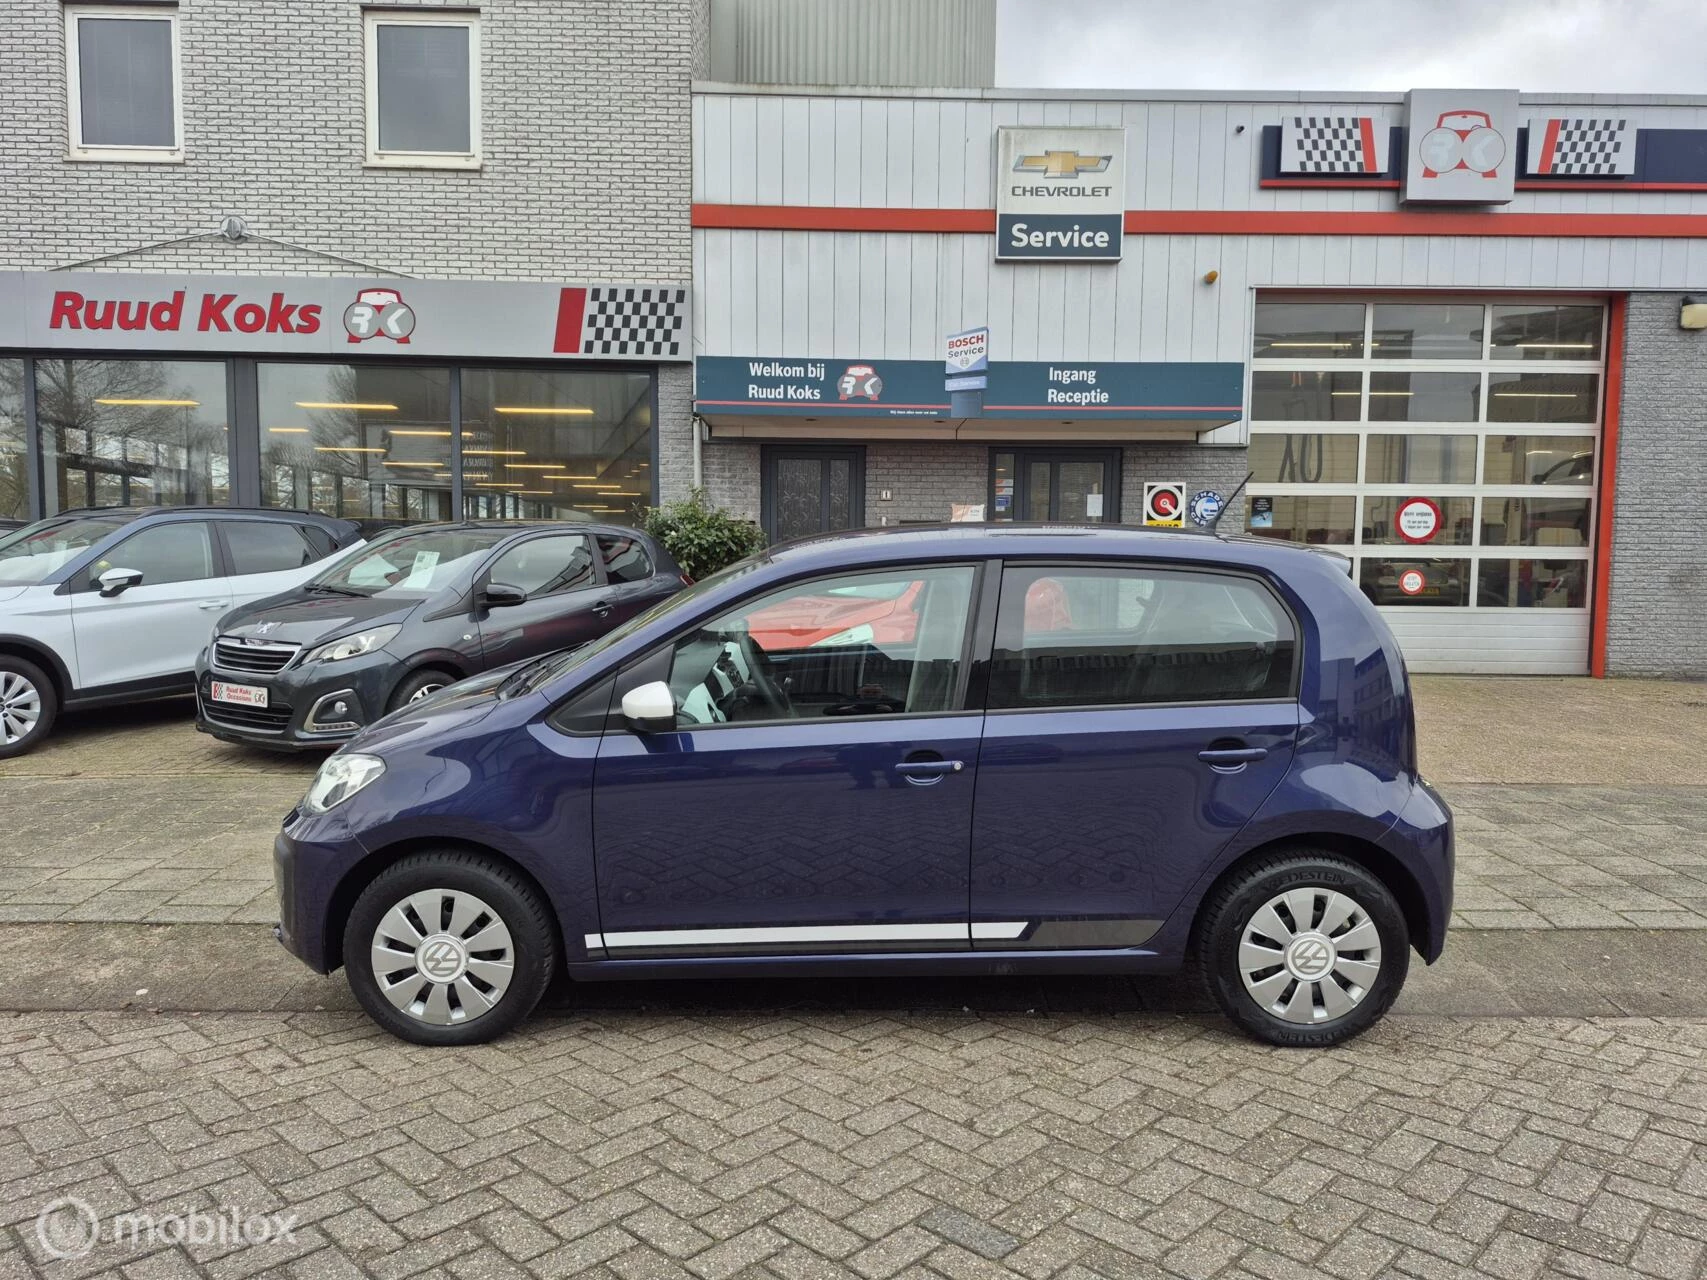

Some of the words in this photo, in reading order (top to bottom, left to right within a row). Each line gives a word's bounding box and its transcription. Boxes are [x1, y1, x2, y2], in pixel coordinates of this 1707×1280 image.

[1011, 185, 1113, 197] CHEVROLET
[1011, 222, 1110, 248] Service
[49, 290, 186, 331] Ruud
[197, 292, 322, 334] Koks
[948, 334, 984, 349] BOSCH
[948, 346, 984, 358] Service
[748, 362, 805, 378] Welkom
[807, 363, 825, 381] bij
[1049, 366, 1097, 385] Ingang
[748, 384, 784, 399] Ruud
[787, 385, 821, 400] Koks
[1047, 388, 1109, 406] Receptie
